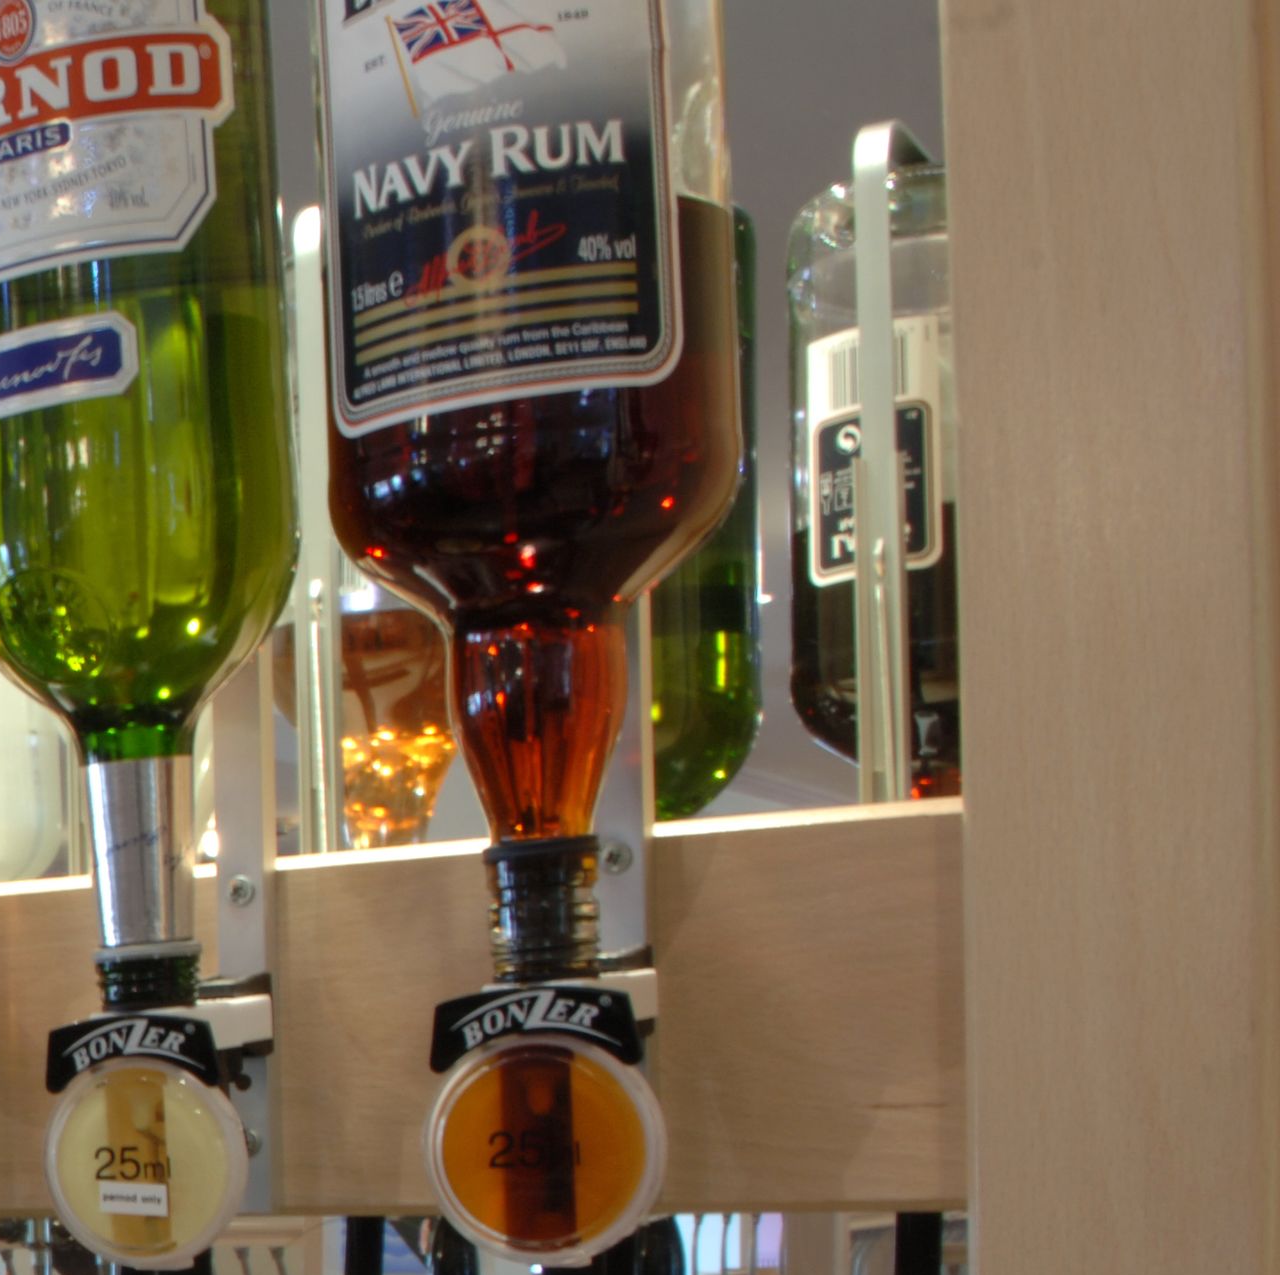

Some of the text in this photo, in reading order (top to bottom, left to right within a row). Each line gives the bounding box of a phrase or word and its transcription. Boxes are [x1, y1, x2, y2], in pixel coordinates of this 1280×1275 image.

[422, 98, 524, 148] Genuine
[352, 140, 473, 220] NAVY
[490, 119, 626, 179] RUM
[577, 235, 637, 262] 40% vol
[461, 987, 600, 1050] BONZER
[73, 1019, 186, 1073] BONZER
[95, 1146, 172, 1180] 25ml
